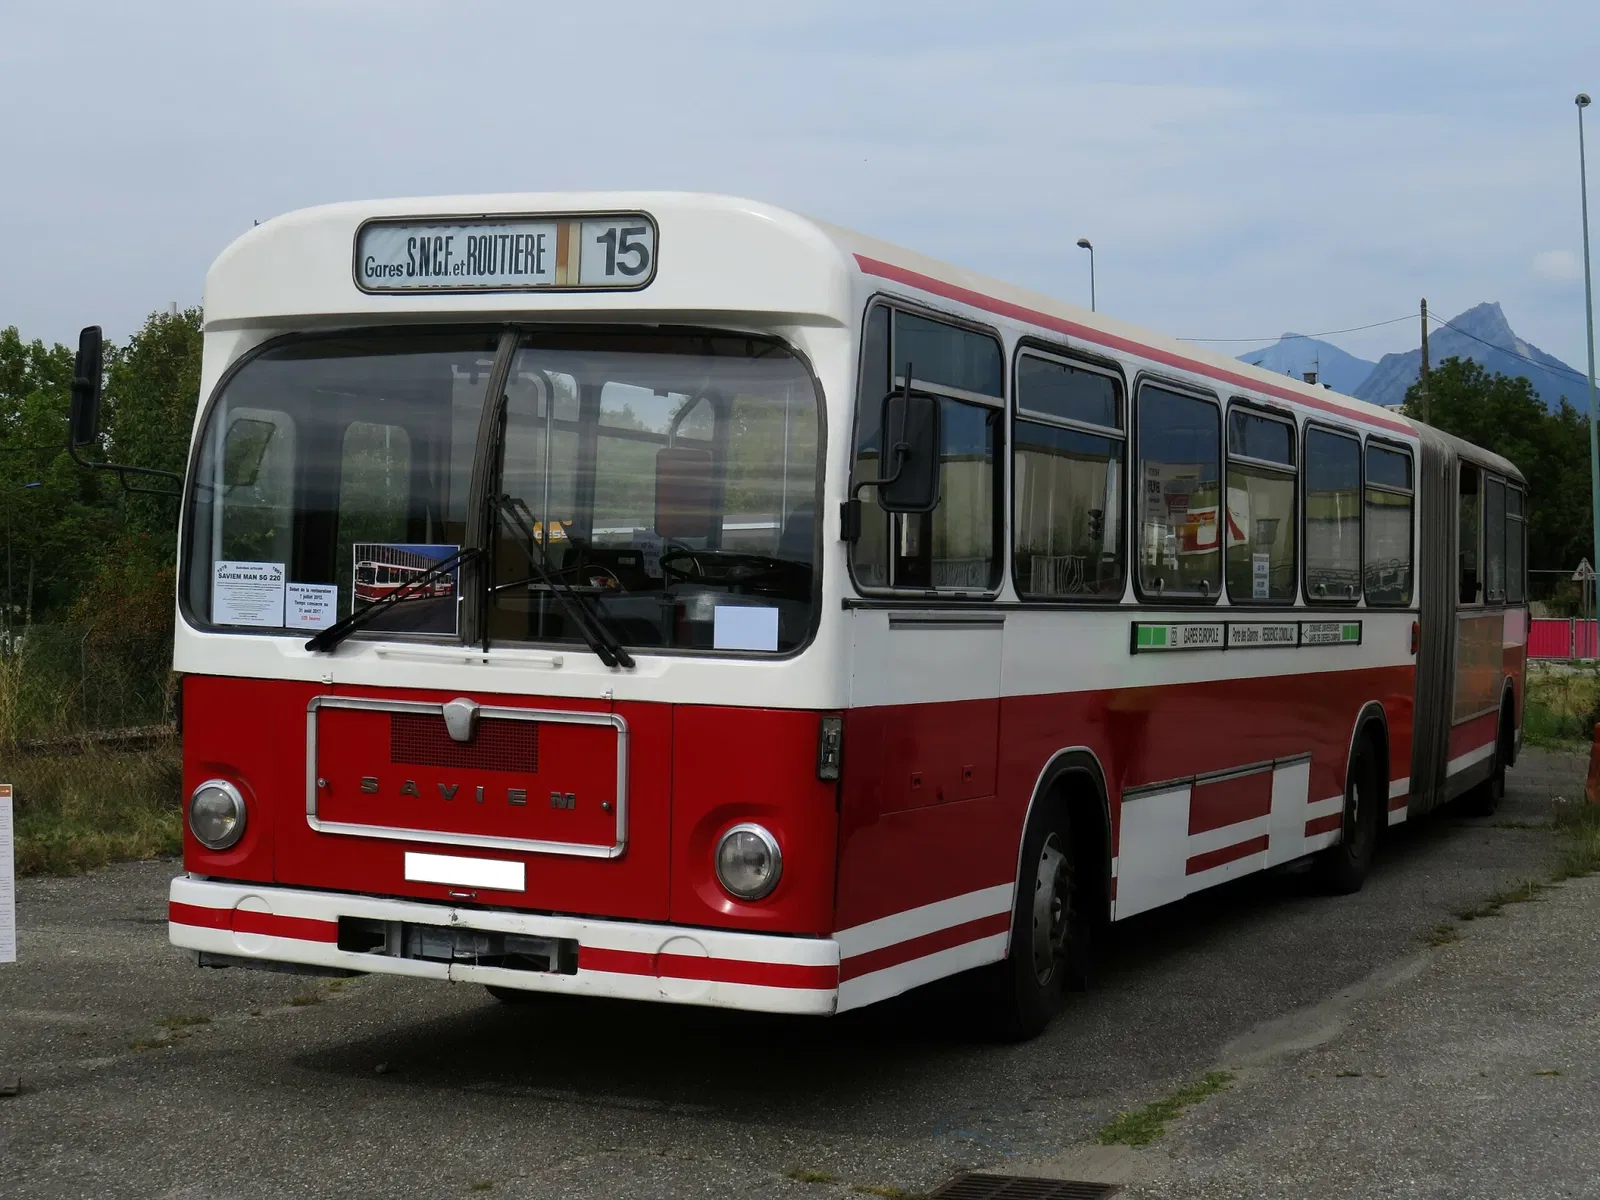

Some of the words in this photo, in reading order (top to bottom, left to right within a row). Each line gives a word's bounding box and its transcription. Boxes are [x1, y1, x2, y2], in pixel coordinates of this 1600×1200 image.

[365, 256, 403, 278] Gares
[453, 263, 466, 277] et
[466, 233, 546, 275] ROUTIERE
[597, 227, 650, 276] 15
[218, 572, 242, 580] SAVIEM
[1199, 627, 1219, 643] EUROPOLE
[360, 776, 576, 810] SAVIEM
